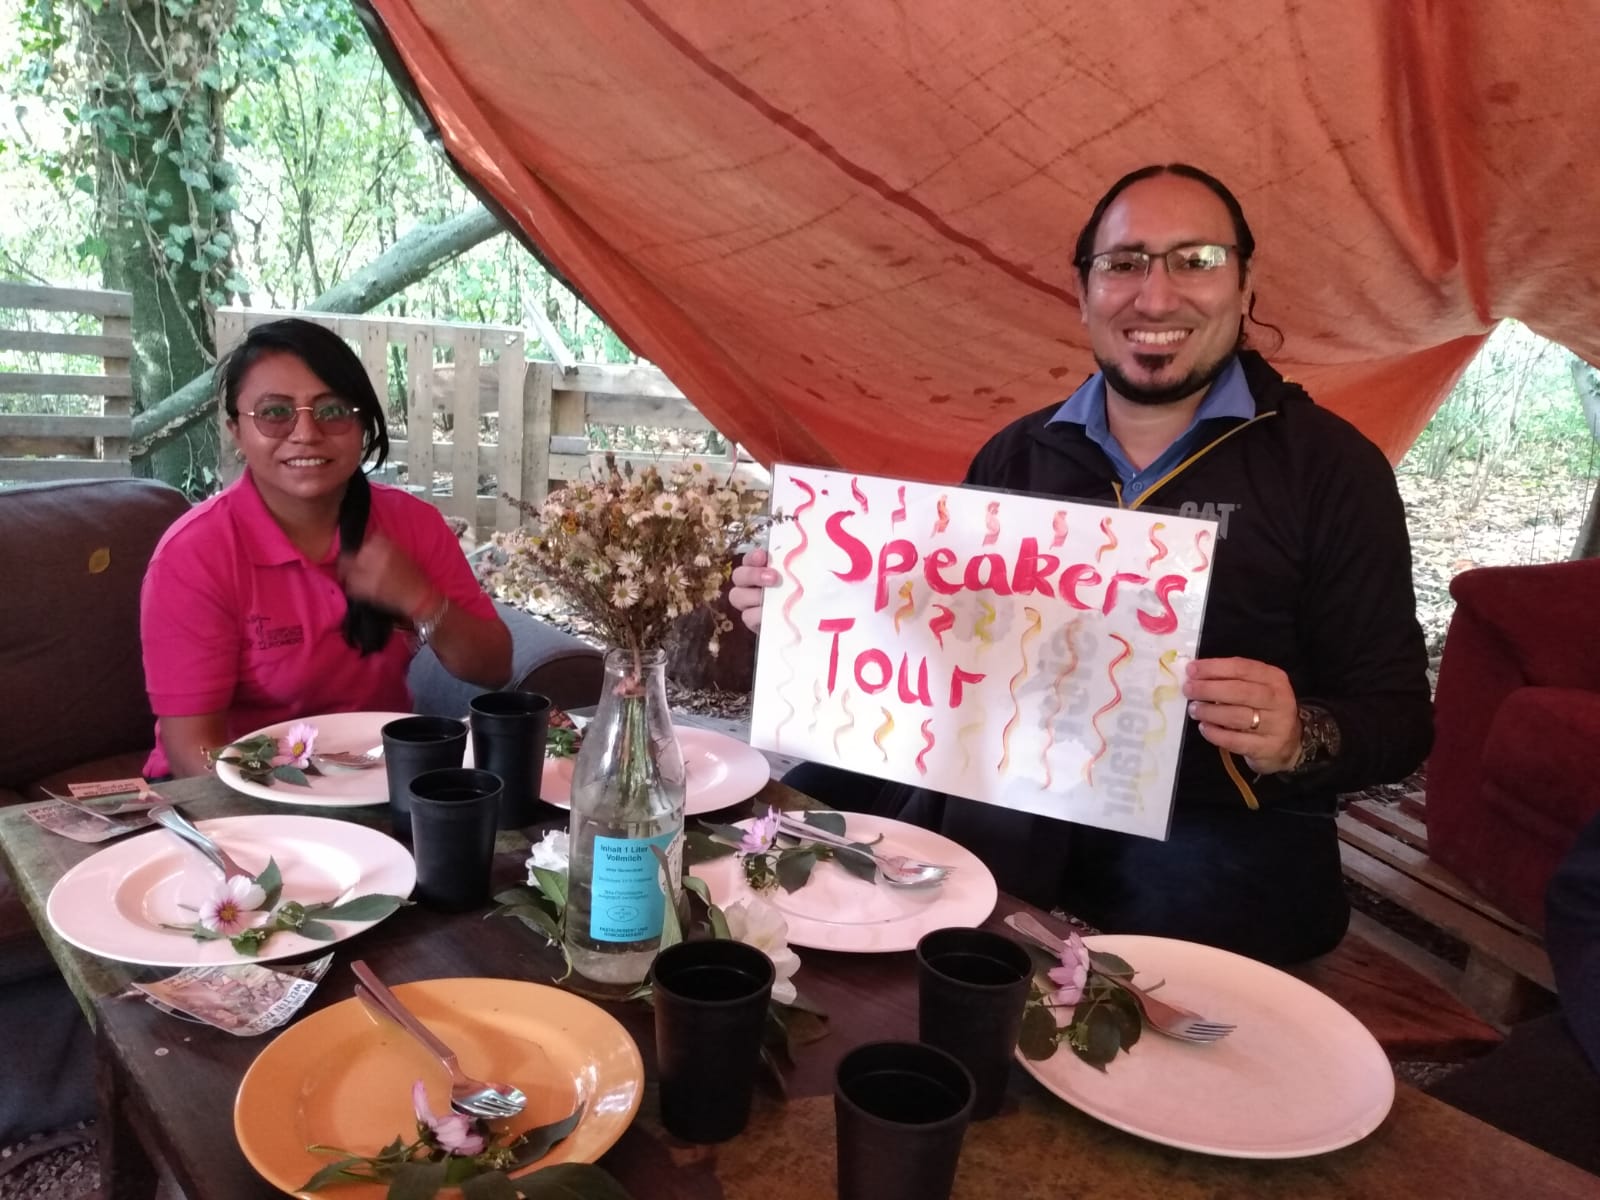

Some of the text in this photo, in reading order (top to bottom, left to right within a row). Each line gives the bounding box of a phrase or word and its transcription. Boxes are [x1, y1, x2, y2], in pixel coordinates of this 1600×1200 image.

[825, 510, 1188, 635] Speakers
[818, 617, 987, 709] Tour
[600, 844, 622, 854] Inhalt
[630, 845, 649, 854] Liter
[606, 853, 642, 862] Vollmilch
